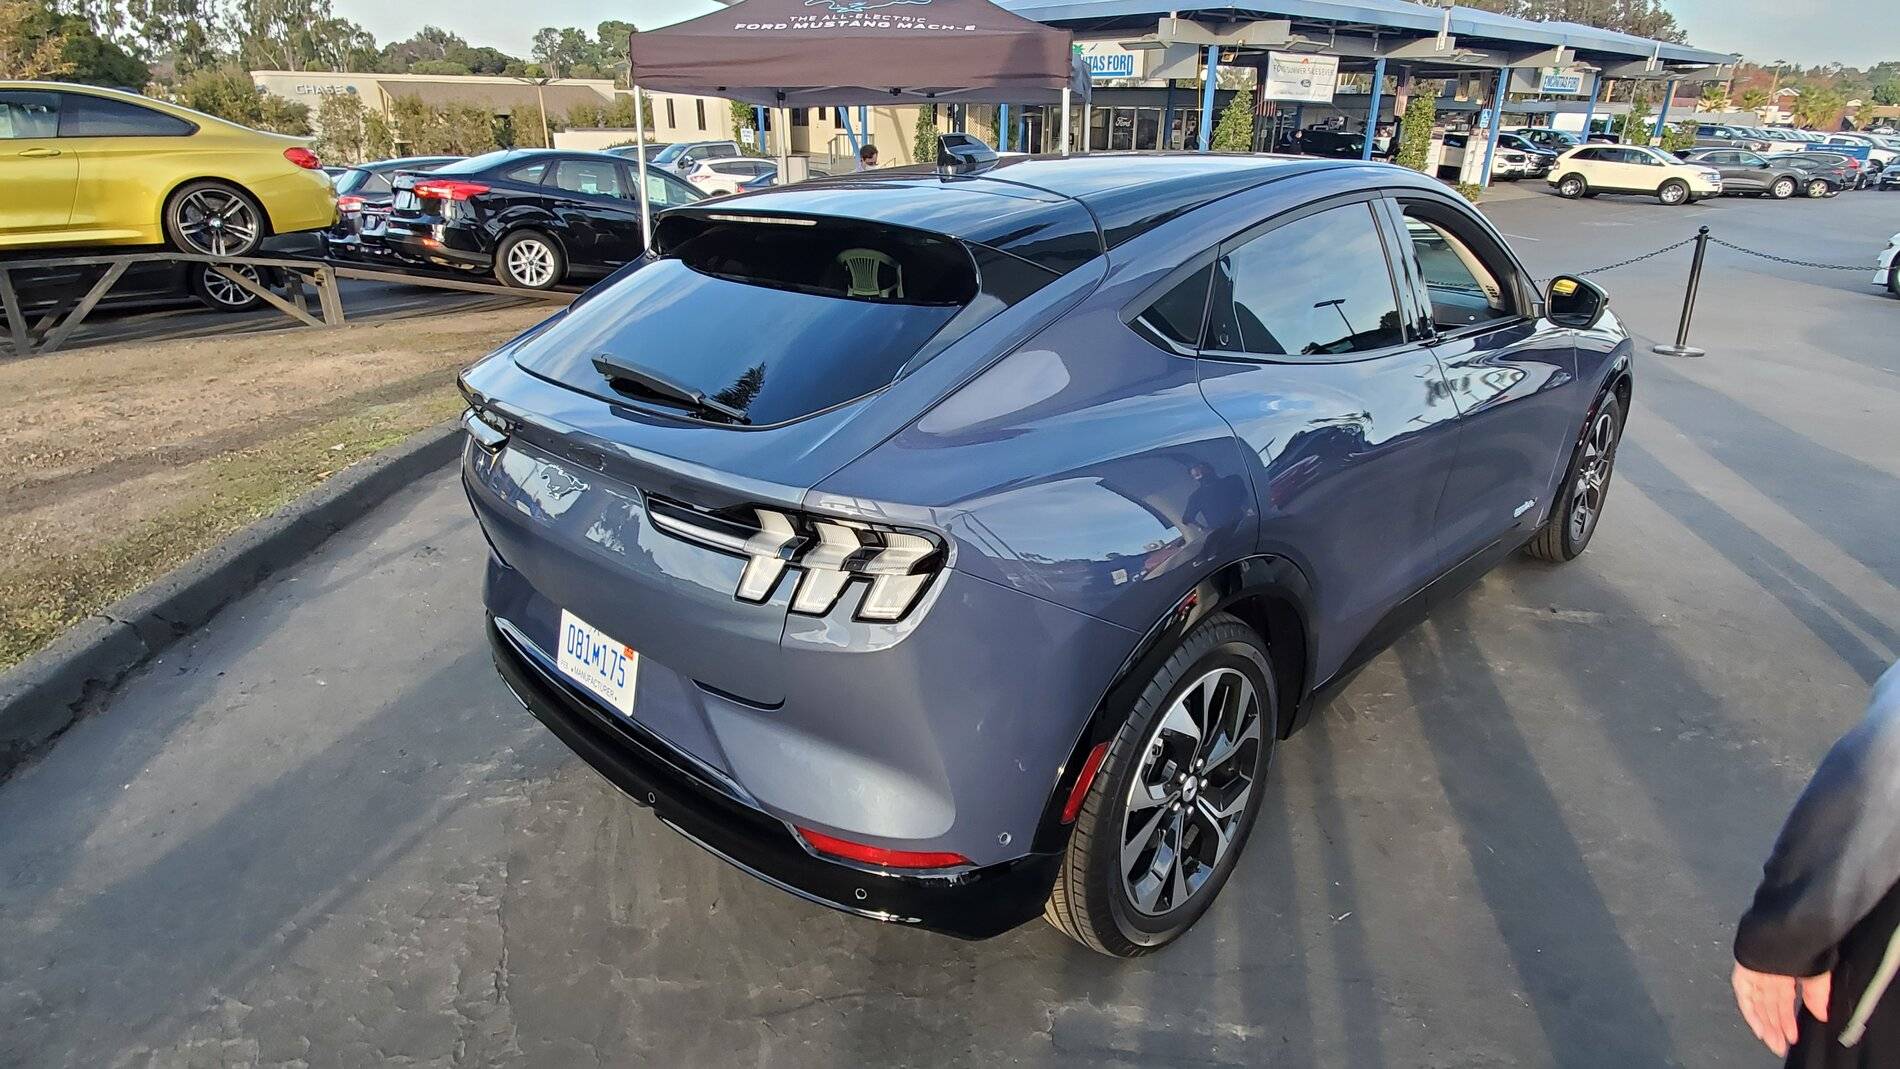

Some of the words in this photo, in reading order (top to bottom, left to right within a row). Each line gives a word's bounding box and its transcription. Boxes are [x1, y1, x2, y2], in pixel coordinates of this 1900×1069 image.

[821, 13, 927, 23] ALL-ELECTRIC
[793, 20, 891, 29] MUSTANG
[897, 22, 976, 31] MACH-E
[1107, 55, 1133, 76] FORD
[296, 84, 344, 95] CHASE
[568, 624, 626, 688] 081M175
